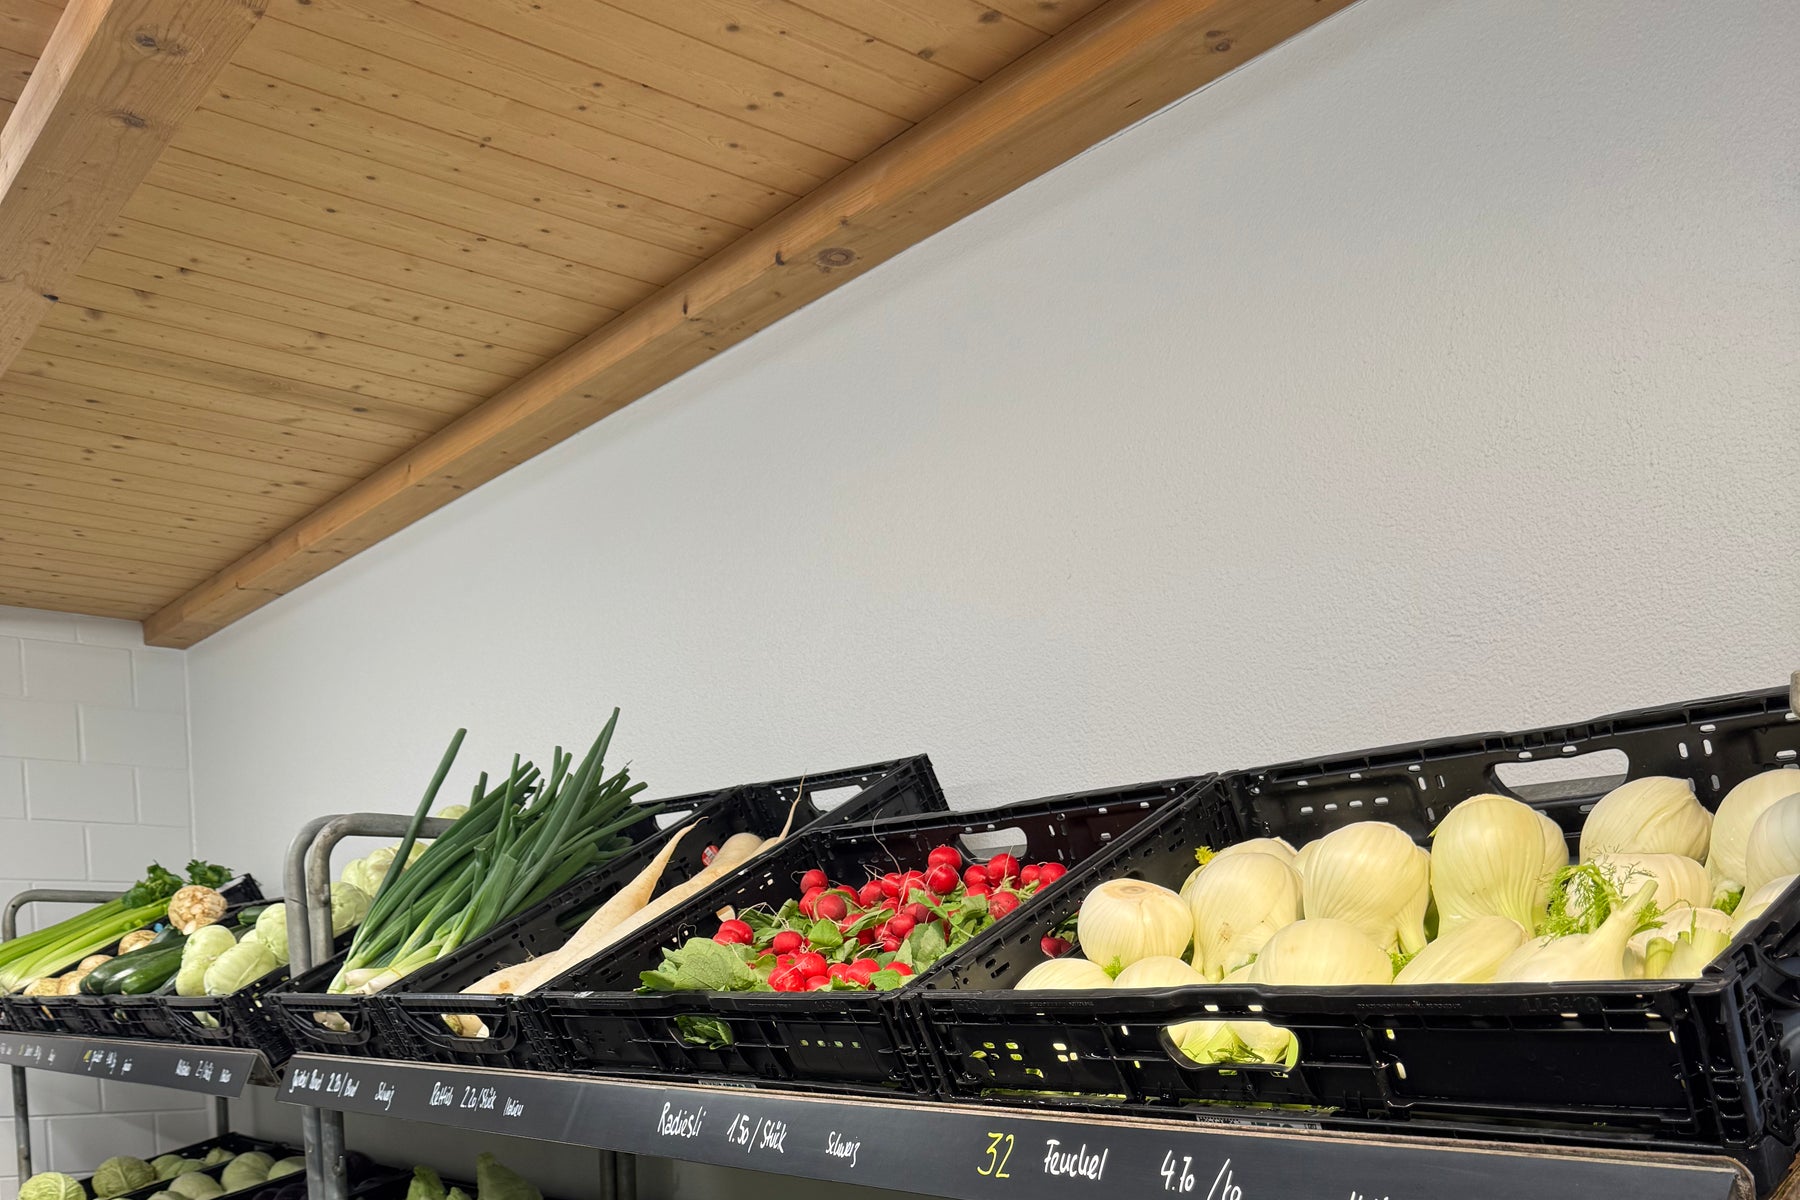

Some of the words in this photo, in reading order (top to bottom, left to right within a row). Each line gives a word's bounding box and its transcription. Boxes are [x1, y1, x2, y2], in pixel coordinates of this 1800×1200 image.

[657, 1101, 706, 1137] Radiesli
[825, 1131, 861, 1168] Schweiz
[976, 1131, 1015, 1179] 32
[1043, 1139, 1109, 1180] Fenchel
